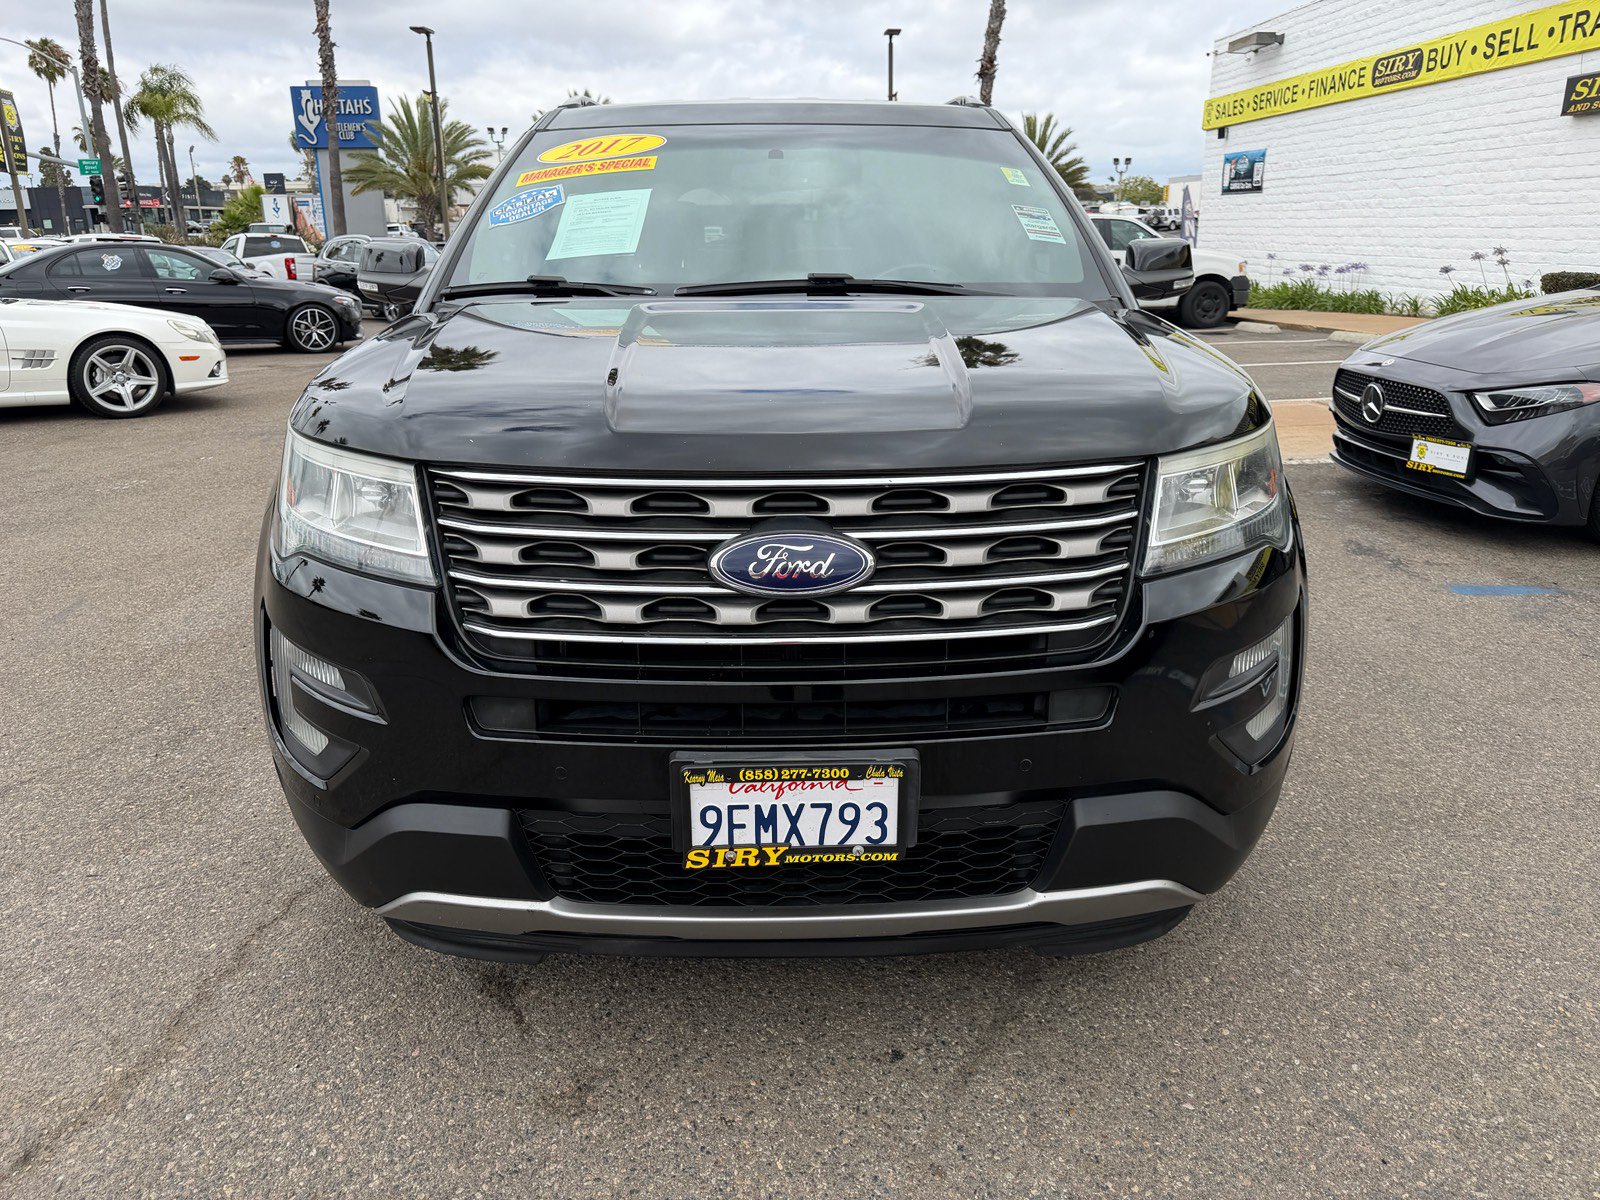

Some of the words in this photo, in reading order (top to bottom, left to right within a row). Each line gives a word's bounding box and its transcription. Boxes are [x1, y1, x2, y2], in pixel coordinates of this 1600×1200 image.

[1426, 39, 1468, 73] BUY
[1483, 23, 1539, 60] SELL
[1375, 51, 1421, 78] SIRY
[1374, 69, 1418, 86] MOTORS.COM
[1215, 97, 1244, 120] SALES
[1252, 84, 1298, 112] SERVICE
[1307, 66, 1367, 99] FINANCE
[1567, 103, 1590, 113] AND
[338, 131, 355, 140] CLUB
[13, 152, 26, 160] ONS
[555, 136, 647, 161] 2017
[521, 163, 595, 183] MANAGER'S
[598, 157, 651, 172] SPECIAL
[499, 197, 554, 221] ADVANTAGE
[508, 205, 546, 222] DEALER
[1406, 461, 1435, 472] SIRY
[748, 543, 836, 579] Ford
[706, 769, 725, 782] Mesa
[738, 768, 779, 781] (858)
[780, 767, 850, 781] 277-7300
[865, 765, 886, 778] Chula
[887, 764, 904, 778] Vista
[729, 778, 863, 800] California
[699, 801, 889, 846] 9FMX793
[685, 847, 790, 869] SIRY
[784, 852, 899, 864] MOTORS.COM
